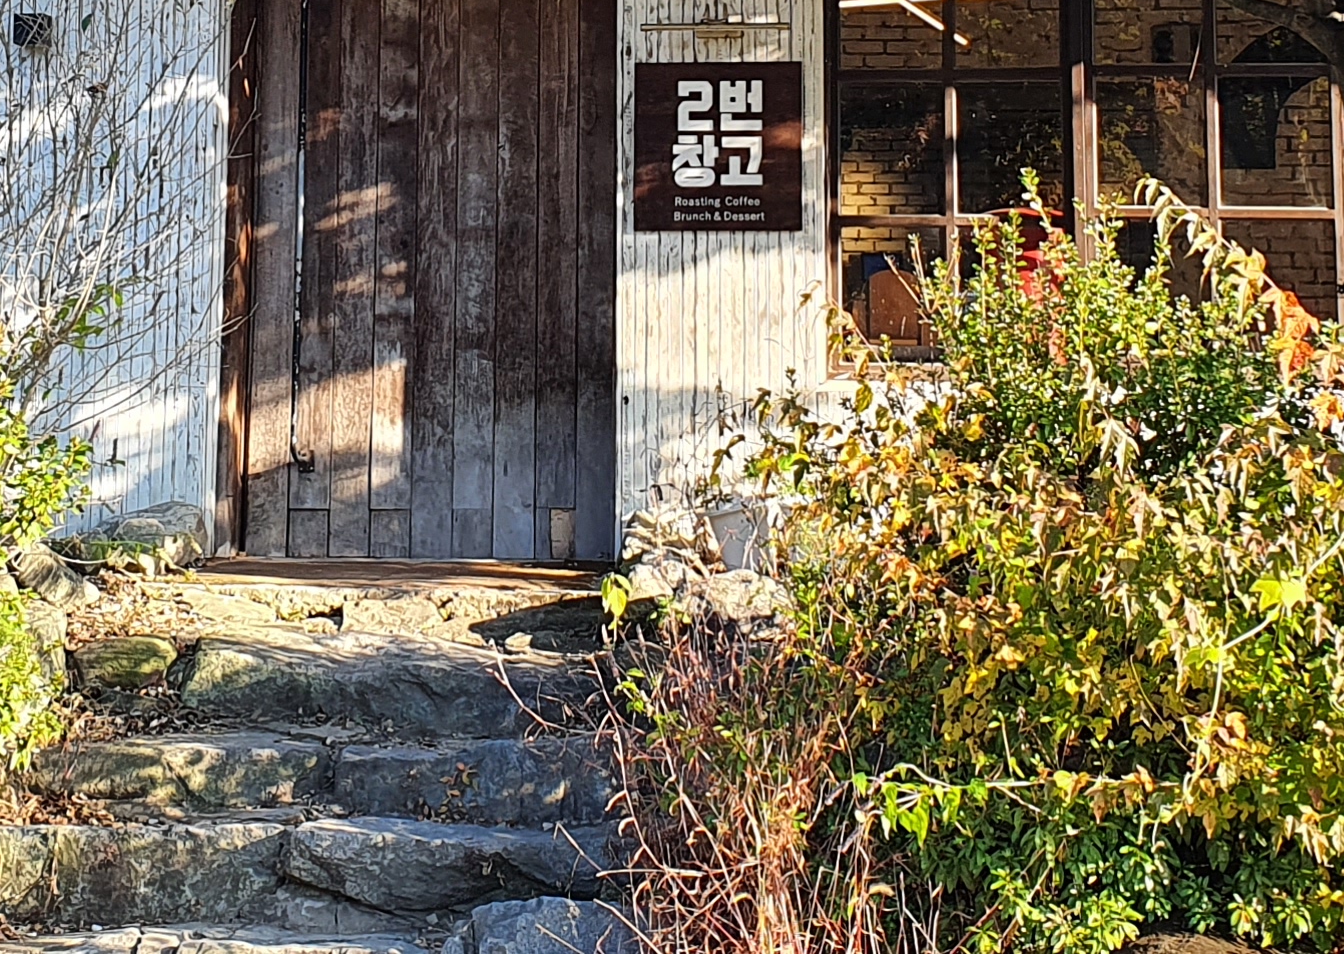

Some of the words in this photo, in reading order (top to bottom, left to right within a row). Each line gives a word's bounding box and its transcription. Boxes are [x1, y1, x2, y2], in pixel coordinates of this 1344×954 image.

[677, 80, 763, 132] 2번
[672, 134, 763, 188] 창고
[673, 211, 712, 222] Brunch
[713, 211, 722, 221] &
[723, 211, 765, 222] Dessert
[674, 196, 721, 208] Roasting
[725, 196, 761, 206] Coffee
